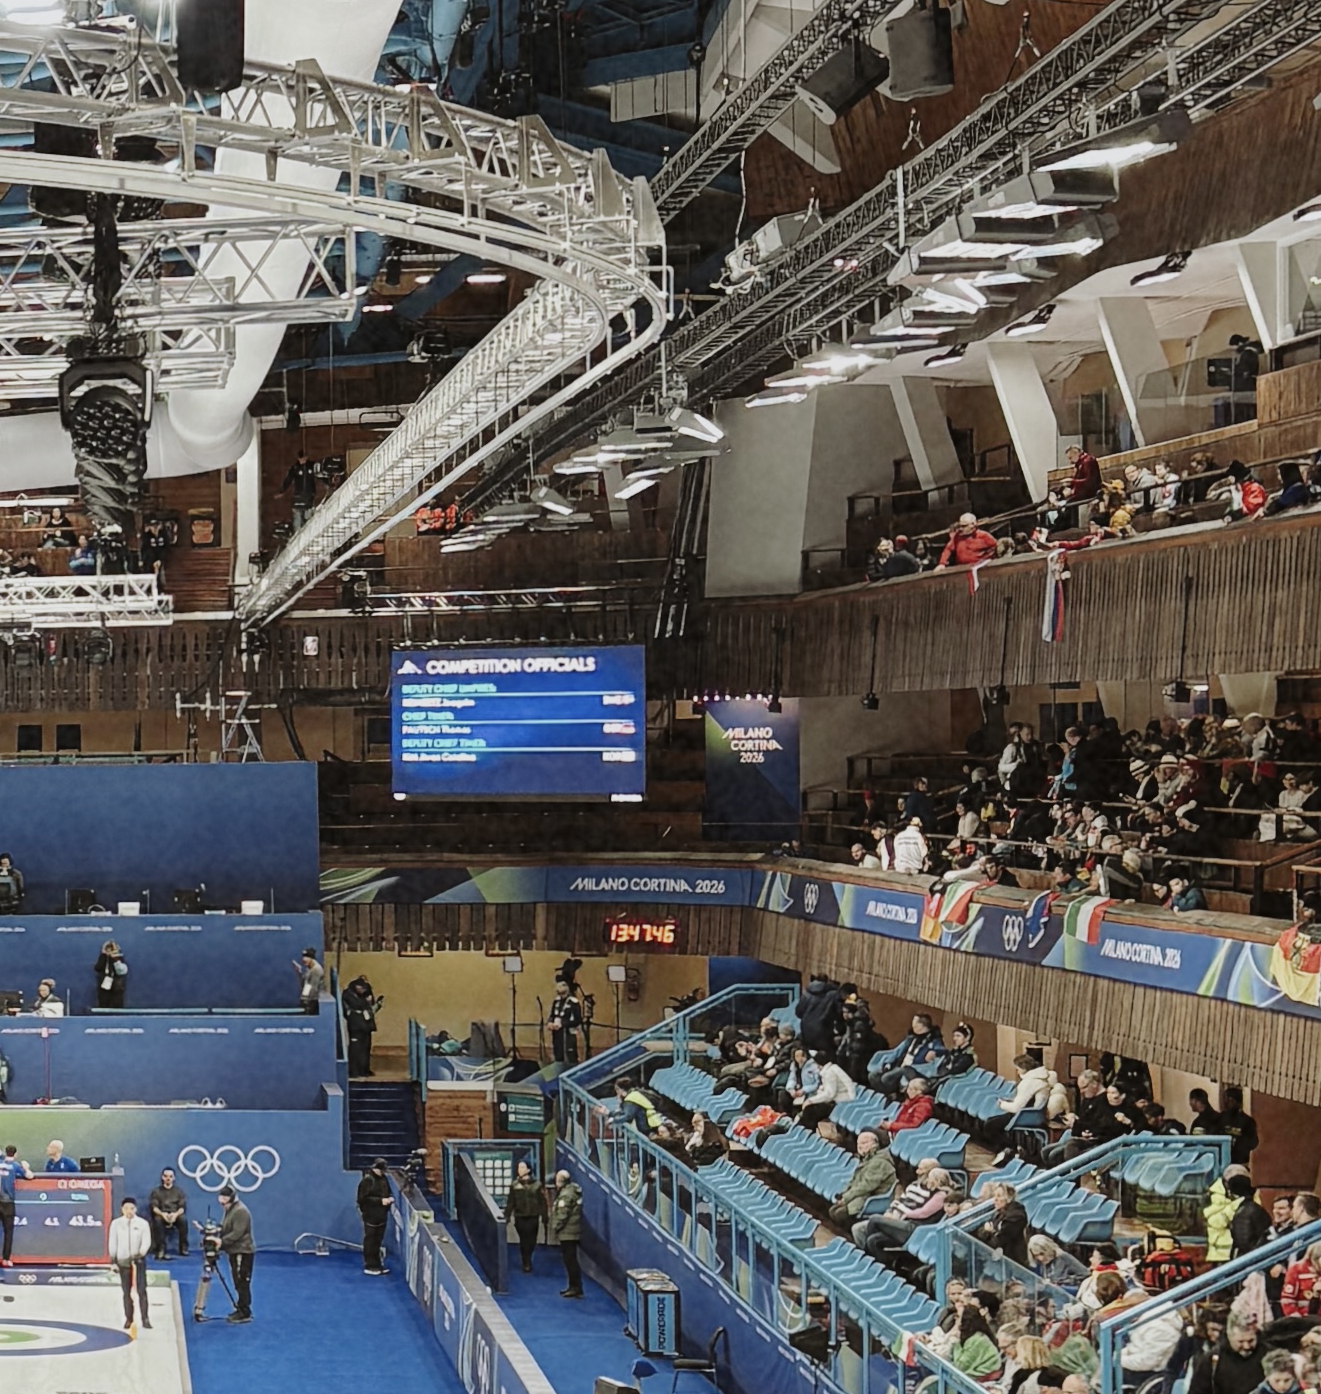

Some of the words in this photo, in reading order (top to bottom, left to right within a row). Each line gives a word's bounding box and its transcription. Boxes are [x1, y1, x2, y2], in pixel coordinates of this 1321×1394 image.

[426, 658, 522, 675] COMPETITION
[523, 656, 597, 673] OFFICIALS
[722, 727, 773, 739] MILANO
[731, 739, 784, 751] CORTINA
[740, 752, 765, 763] 2026
[569, 877, 628, 891] MILANO
[630, 878, 693, 893] CORTINA
[695, 880, 726, 894] 2026
